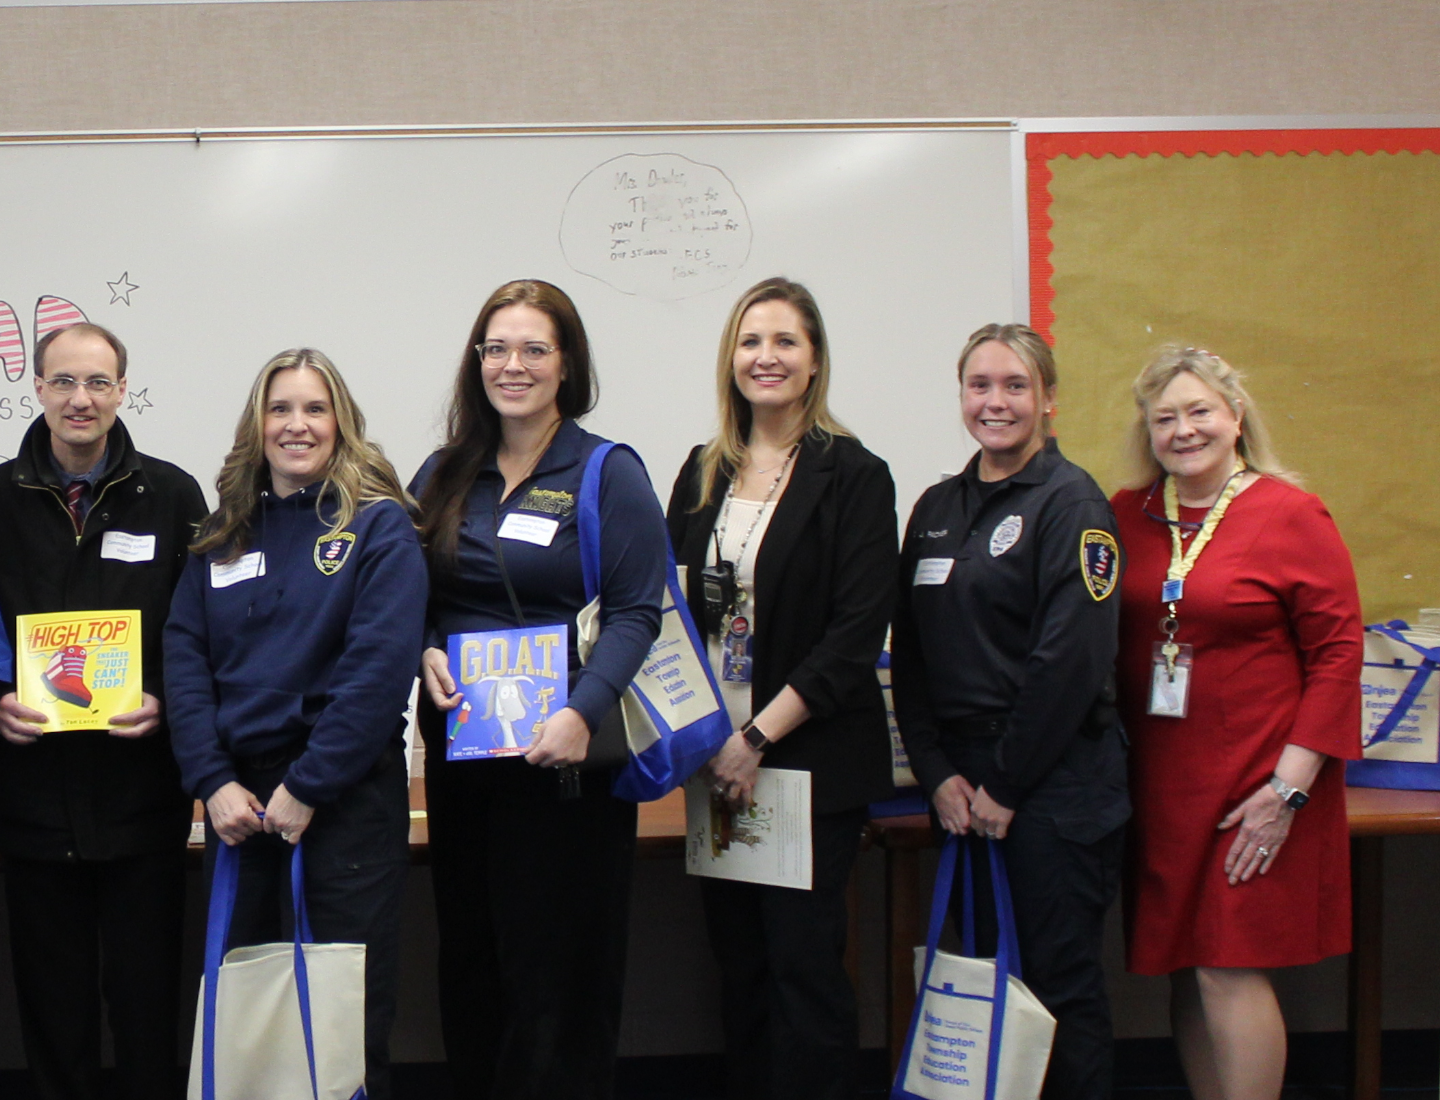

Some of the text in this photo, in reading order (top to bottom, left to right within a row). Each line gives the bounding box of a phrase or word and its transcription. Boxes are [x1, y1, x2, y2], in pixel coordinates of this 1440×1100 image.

[32, 620, 127, 648] HIGH TOP
[97, 651, 129, 659] SNEAKER
[460, 633, 560, 686] G.O.A.T.
[105, 659, 129, 668] JUST
[94, 668, 127, 679] CAN'T
[92, 678, 125, 689] STOP!
